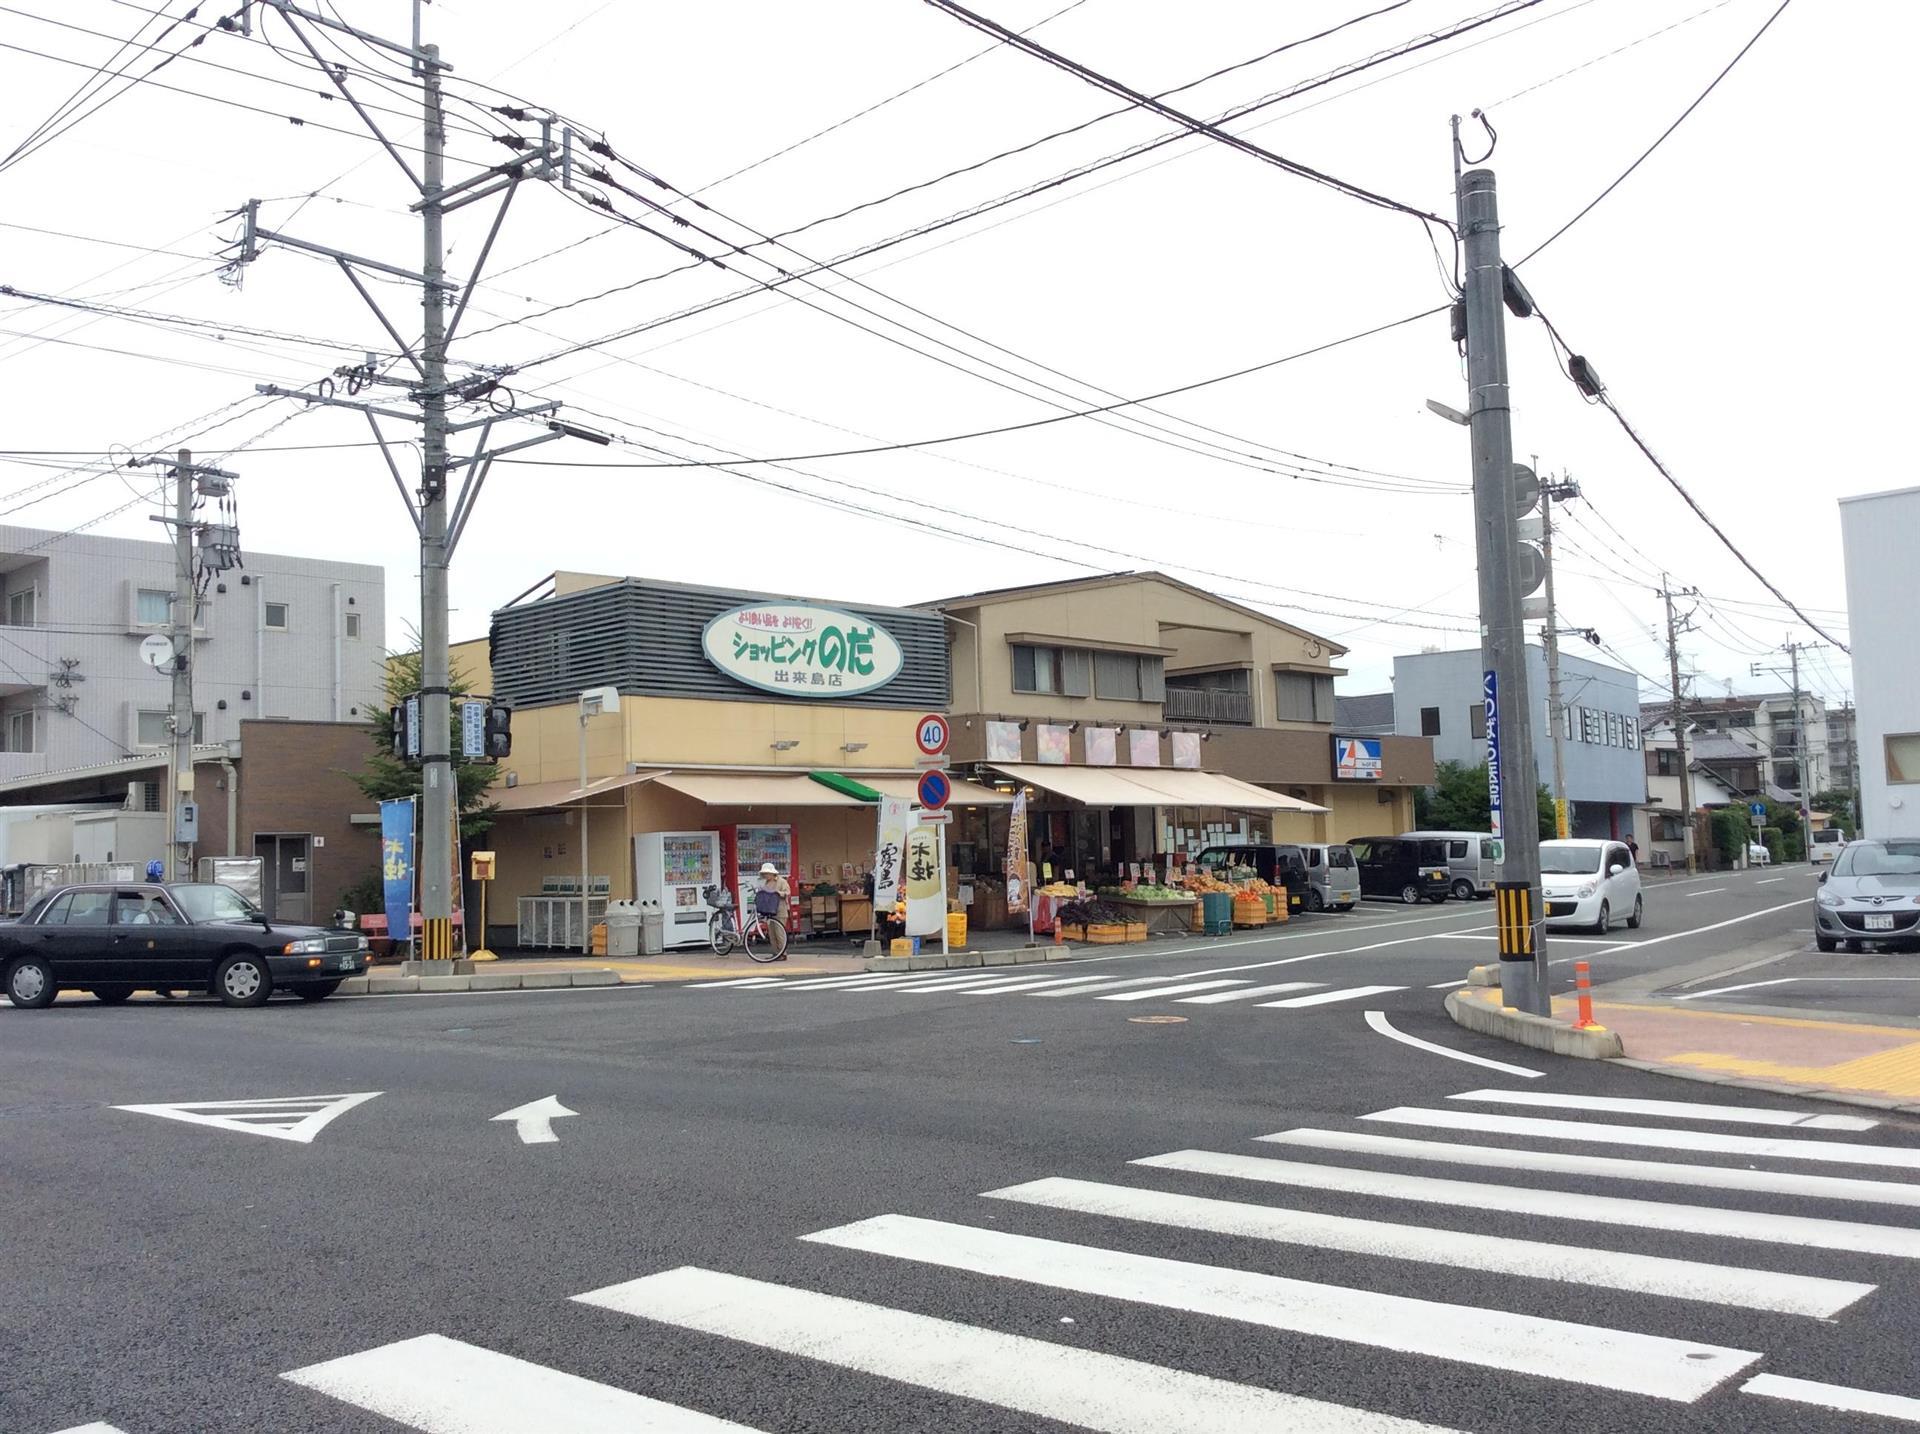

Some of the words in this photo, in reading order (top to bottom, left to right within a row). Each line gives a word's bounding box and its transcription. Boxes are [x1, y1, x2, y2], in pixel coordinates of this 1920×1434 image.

[734, 627, 875, 676] ショッピングのだ
[774, 670, 842, 687] 出来島店
[923, 725, 942, 743] 40
